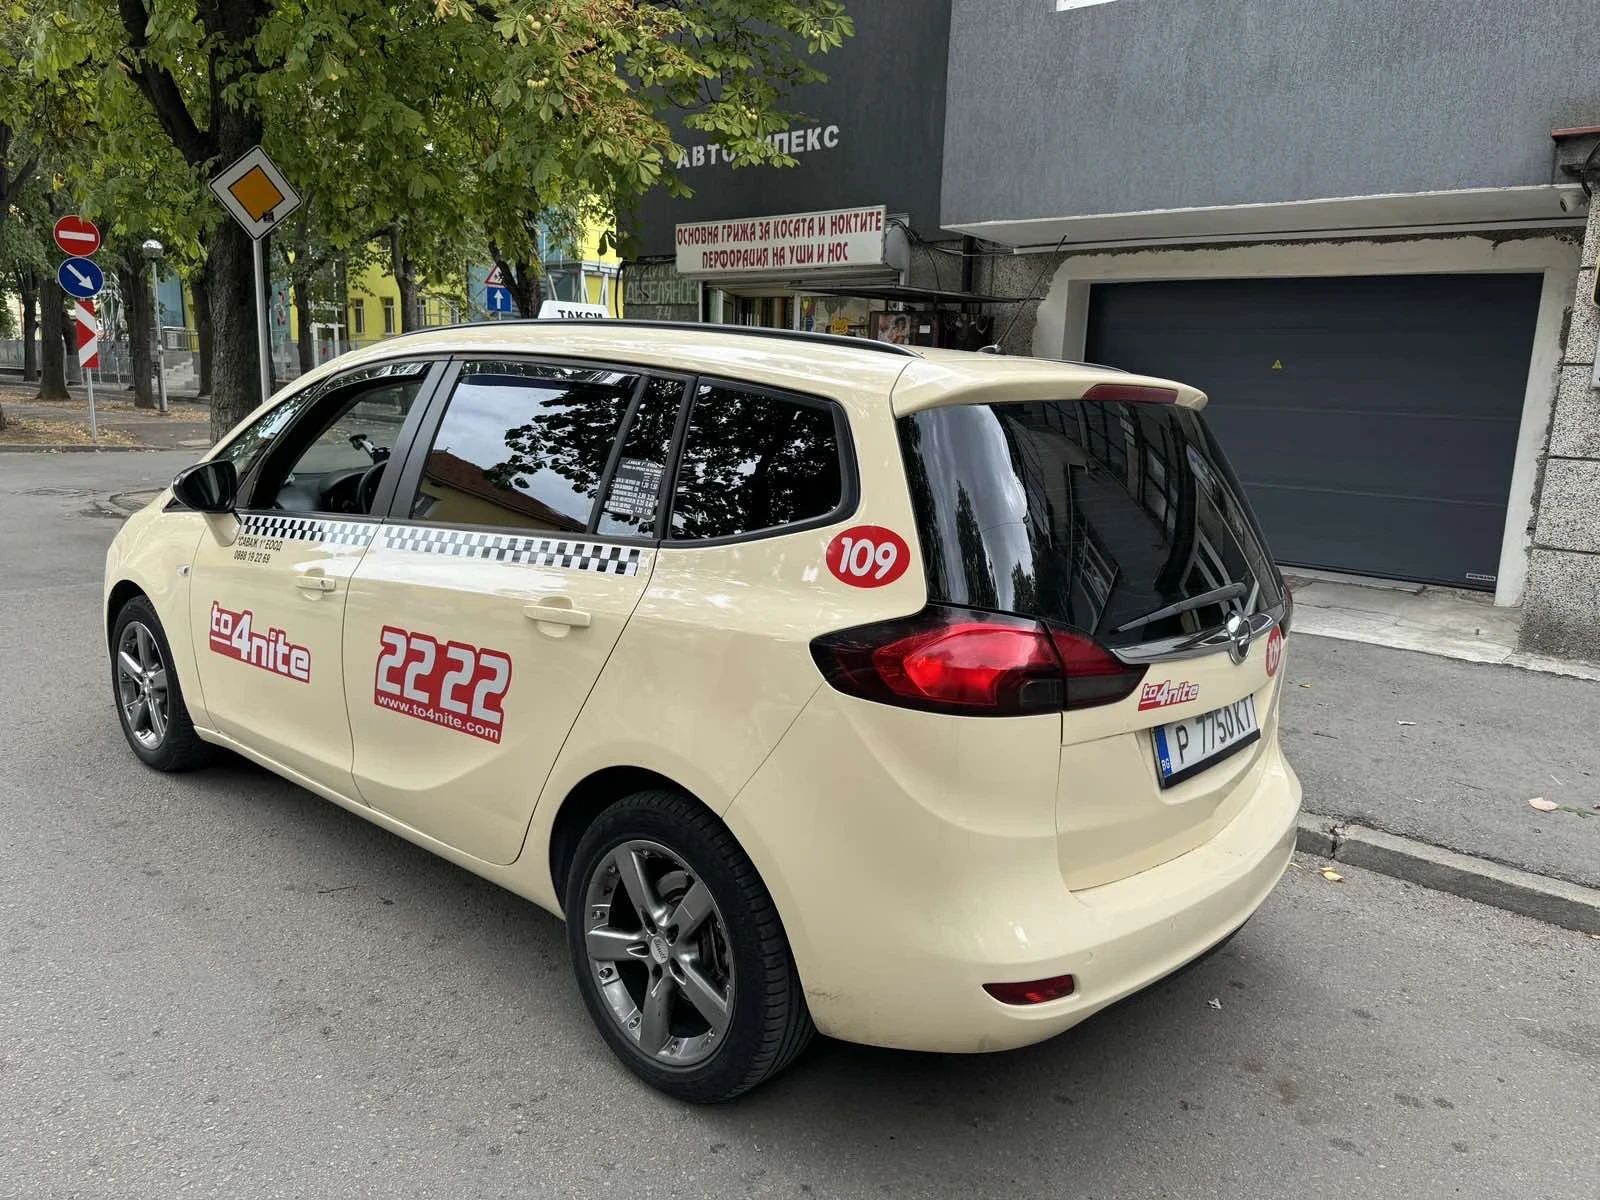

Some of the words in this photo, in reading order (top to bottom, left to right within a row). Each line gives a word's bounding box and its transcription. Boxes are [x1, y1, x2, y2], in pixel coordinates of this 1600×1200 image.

[677, 226, 719, 246] ОСНОВНА
[721, 223, 756, 243] ГРИЖА
[759, 220, 770, 241] ЗА
[774, 216, 814, 239] КОСАТА
[818, 216, 825, 236] И
[830, 211, 882, 236] НОКТИТЕ
[702, 247, 768, 269] ПЕРФОРАЦИЯ
[773, 246, 785, 265] НА
[789, 244, 814, 263] УШИ
[817, 243, 824, 261] И
[828, 242, 849, 263] НОС
[265, 539, 283, 552] ЕООД
[839, 537, 897, 580] 109
[210, 603, 309, 679] to4nite
[1141, 680, 1199, 706] to4nite
[378, 694, 499, 740] www.to4nite.com
[1176, 724, 1189, 764] P
[1162, 758, 1171, 770] BG
